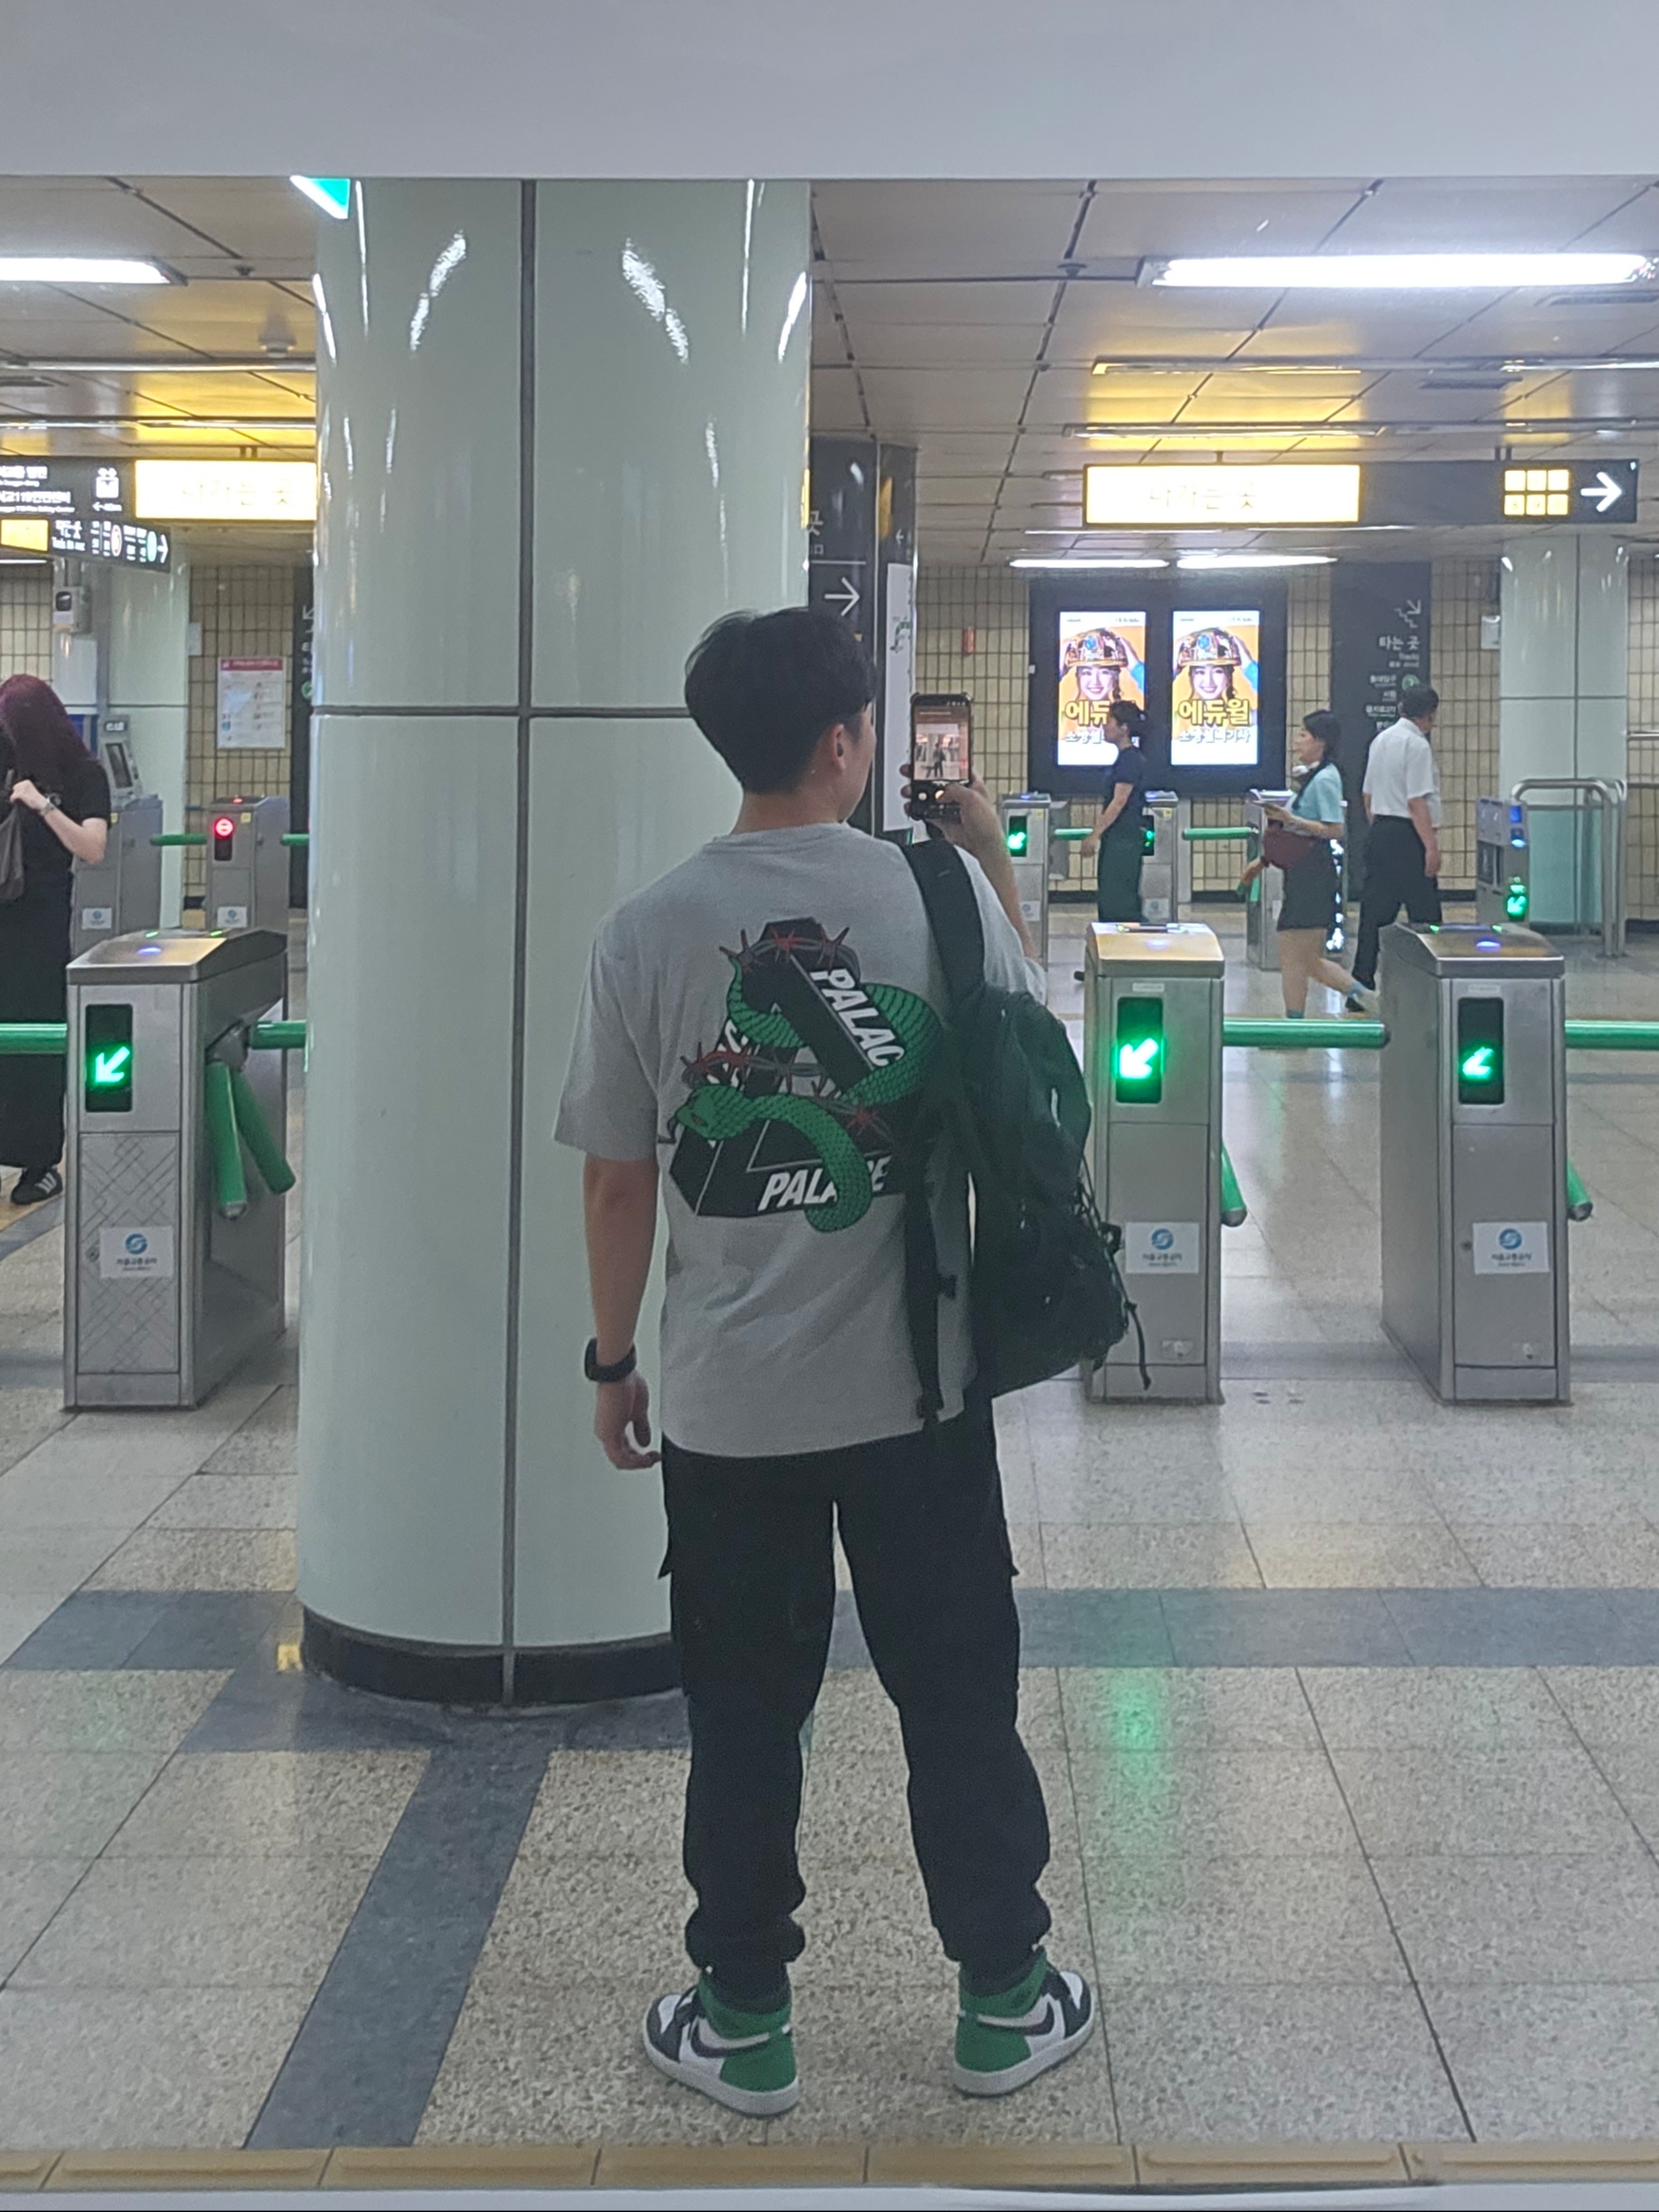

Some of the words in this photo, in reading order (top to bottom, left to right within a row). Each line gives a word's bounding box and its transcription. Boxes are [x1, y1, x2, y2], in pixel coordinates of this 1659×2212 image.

[181, 478, 257, 506] 나가는
[271, 478, 293, 506] 곳
[1149, 483, 1224, 510] 나가는
[1238, 481, 1258, 510] 곳
[1064, 699, 1111, 727] 에듀
[1178, 698, 1252, 727] 에듀윌
[810, 969, 905, 1067] PALAC
